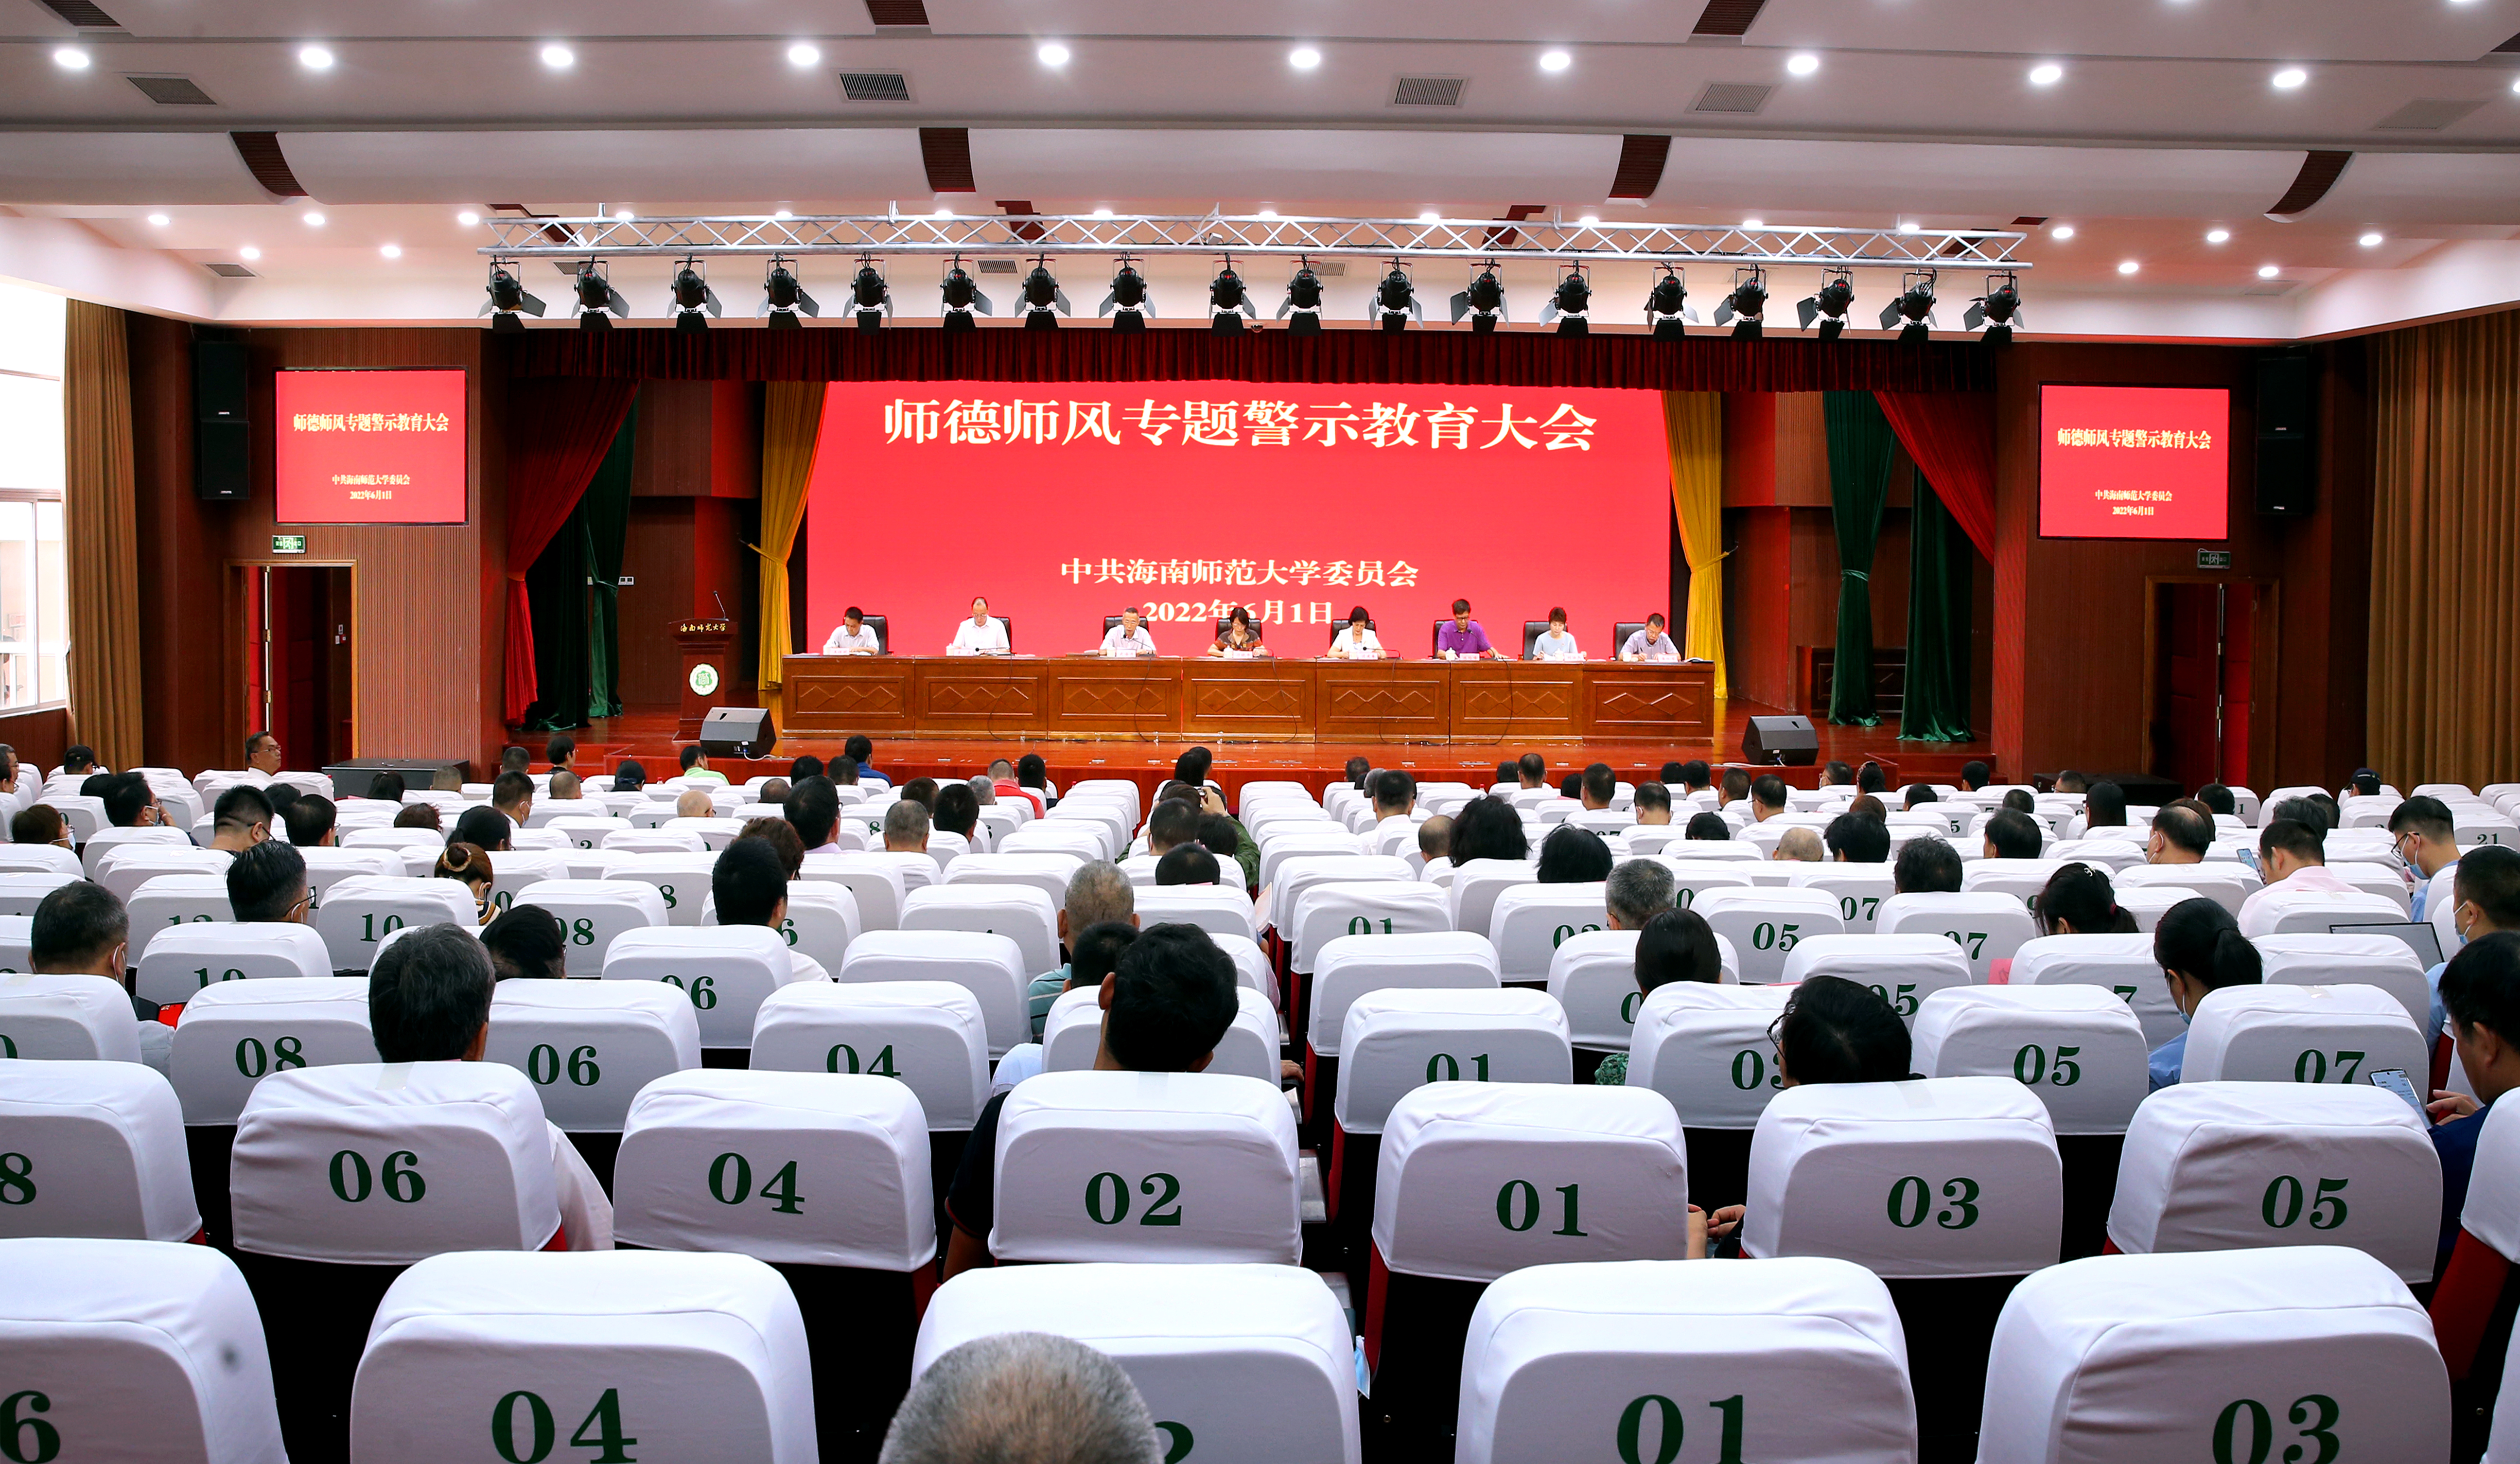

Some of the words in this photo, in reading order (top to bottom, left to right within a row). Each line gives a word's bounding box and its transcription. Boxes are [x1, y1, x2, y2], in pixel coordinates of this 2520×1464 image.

[293, 412, 449, 432] 师德师风专题警示教育大会
[885, 398, 1597, 451] 师德师风专题警示教育大会
[2057, 428, 2211, 449] 师德师风专题警示教育大会
[332, 474, 411, 486] 中共海南师范大学委员会
[349, 489, 392, 500] 2022年6月1日
[2095, 489, 2172, 501] 中共海南师范大学委员会
[2112, 505, 2154, 516] 2022年6月1日
[1061, 557, 1419, 587] 中共海南师范大学委员会
[2477, 833, 2498, 845] 21
[1348, 916, 1392, 935] 01
[1841, 897, 1880, 921] 07
[361, 913, 404, 942] 10
[1752, 922, 1799, 952] 05
[235, 1036, 307, 1078] 08
[527, 1043, 600, 1086] 06
[826, 1044, 901, 1078] 04
[1426, 1053, 1489, 1083] 01
[1731, 1049, 1785, 1090] 0
[2013, 1044, 2081, 1087] 05
[2294, 1049, 2365, 1084] 07
[329, 1150, 426, 1203] 06
[708, 1152, 805, 1215] 04
[1085, 1172, 1182, 1226] 02
[1496, 1180, 1588, 1237] 01
[1887, 1176, 1980, 1230] 03
[2262, 1175, 2349, 1231] 05
[491, 1388, 638, 1464] 04
[1617, 1394, 1744, 1464] 01
[2213, 1394, 2341, 1464] 03
